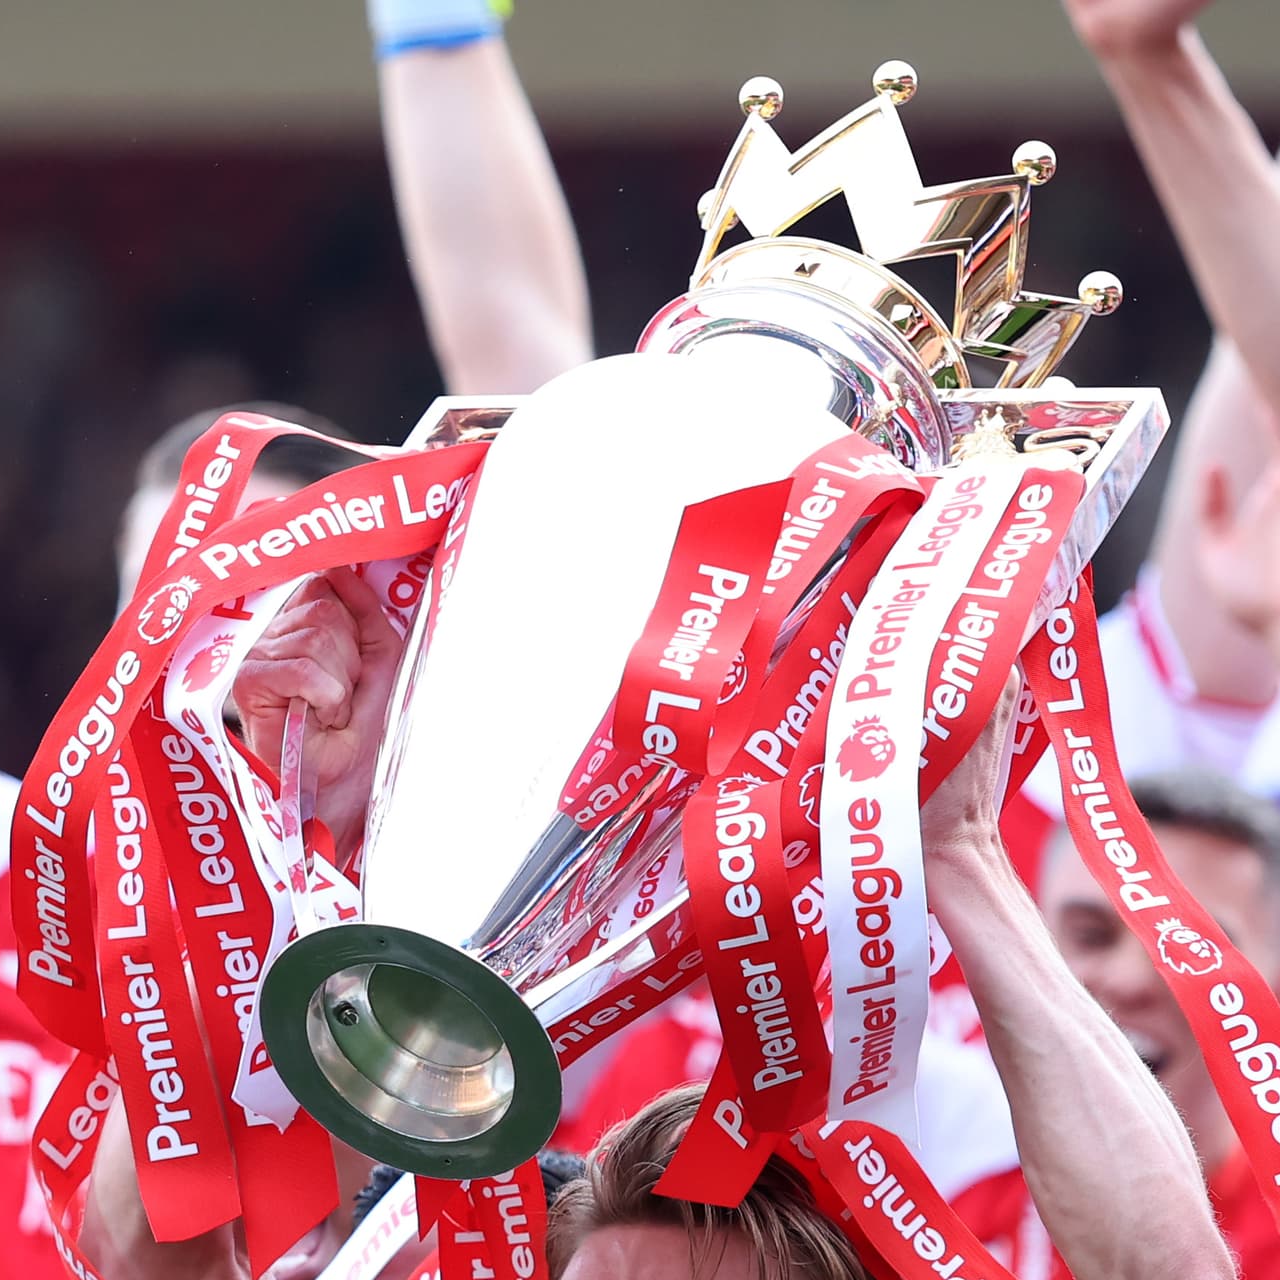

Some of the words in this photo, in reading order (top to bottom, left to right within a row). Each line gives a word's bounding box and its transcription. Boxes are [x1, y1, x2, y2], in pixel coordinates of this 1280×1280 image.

[199, 491, 384, 580] Premier
[656, 562, 751, 682] Premier
[762, 477, 846, 594] emier
[846, 577, 926, 703] Premier
[893, 472, 987, 572] League
[919, 601, 1000, 769] remier
[975, 482, 1054, 599] League
[28, 650, 141, 838] League
[161, 734, 246, 918] League
[1057, 727, 1171, 913] Premier
[25, 840, 75, 987] Premier
[107, 750, 148, 940] Leagu
[715, 792, 770, 951] Leagu
[846, 796, 903, 995] League
[120, 954, 199, 1162] Premier
[735, 948, 804, 1092] Premier
[843, 997, 896, 1106] Premier
